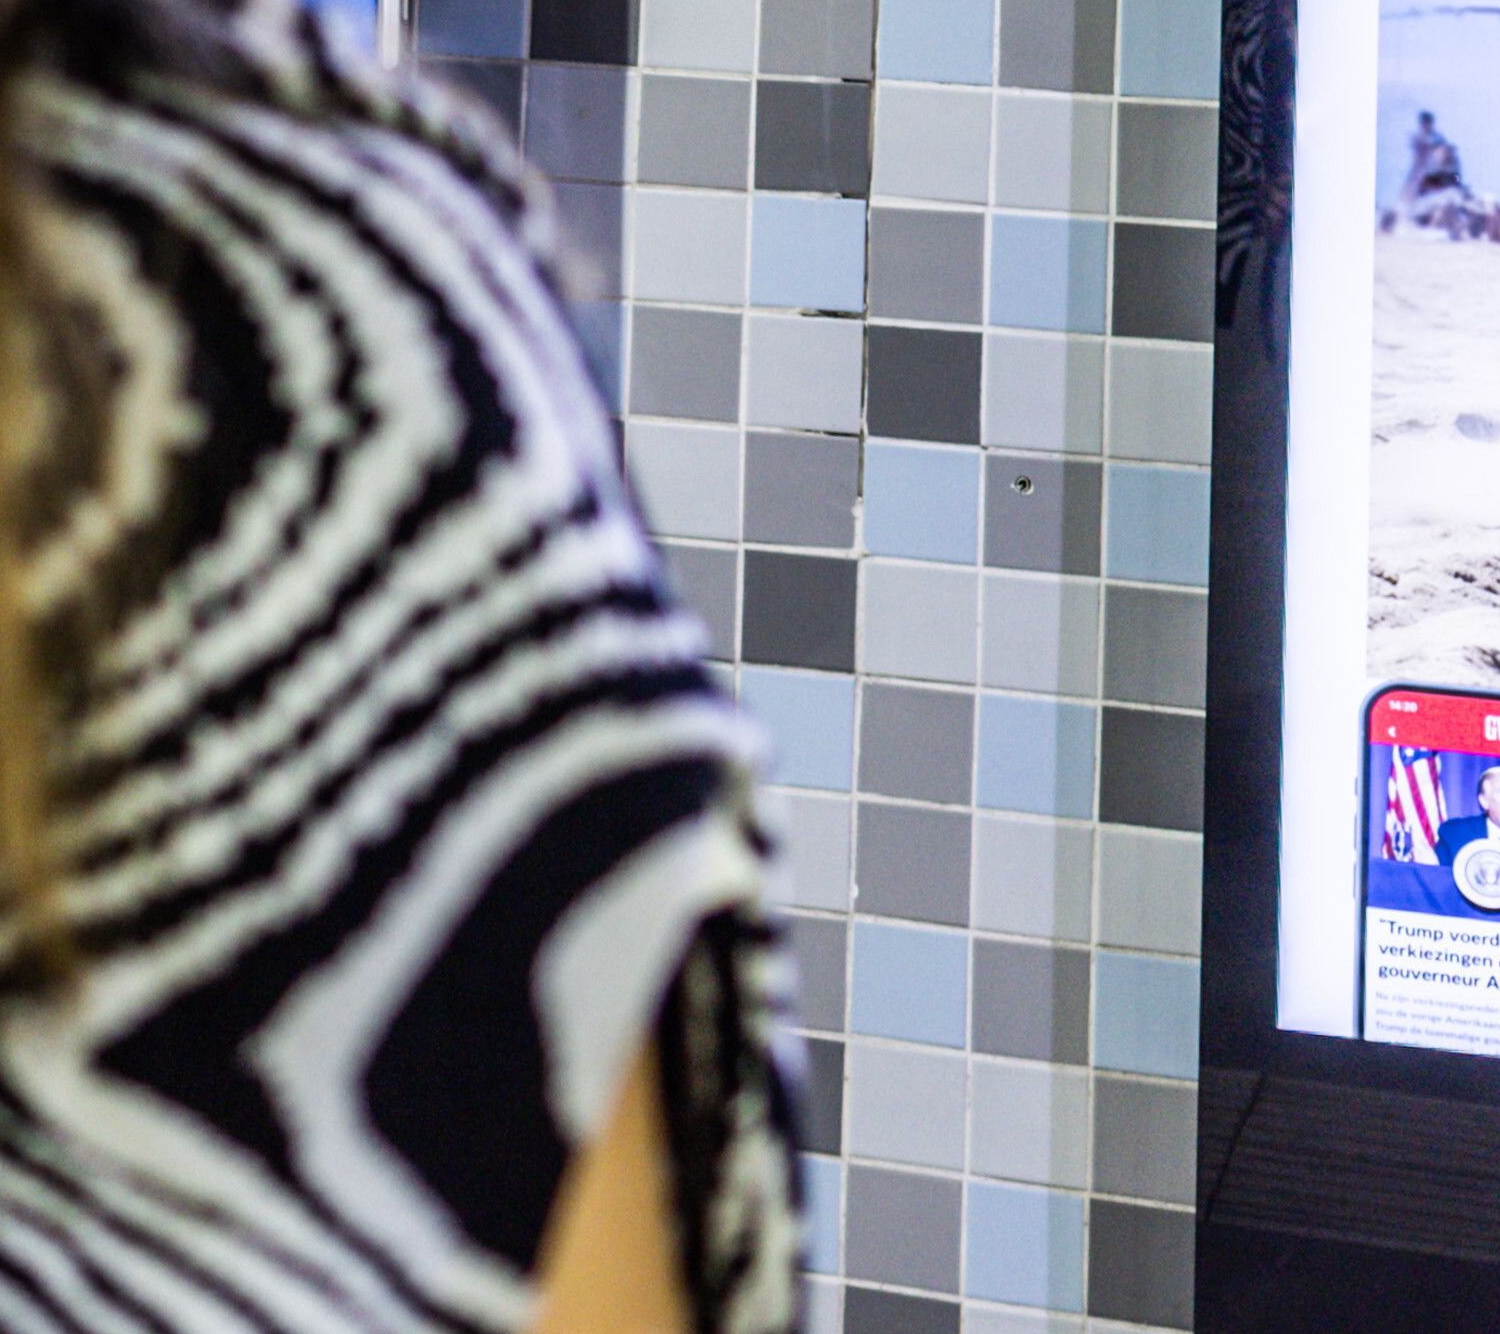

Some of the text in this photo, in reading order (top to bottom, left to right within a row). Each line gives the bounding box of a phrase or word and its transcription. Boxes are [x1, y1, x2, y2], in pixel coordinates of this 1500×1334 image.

[1379, 918, 1444, 942] "Trump
[1379, 943, 1493, 968] verkiezingen
[1379, 966, 1480, 987] gouverneur
